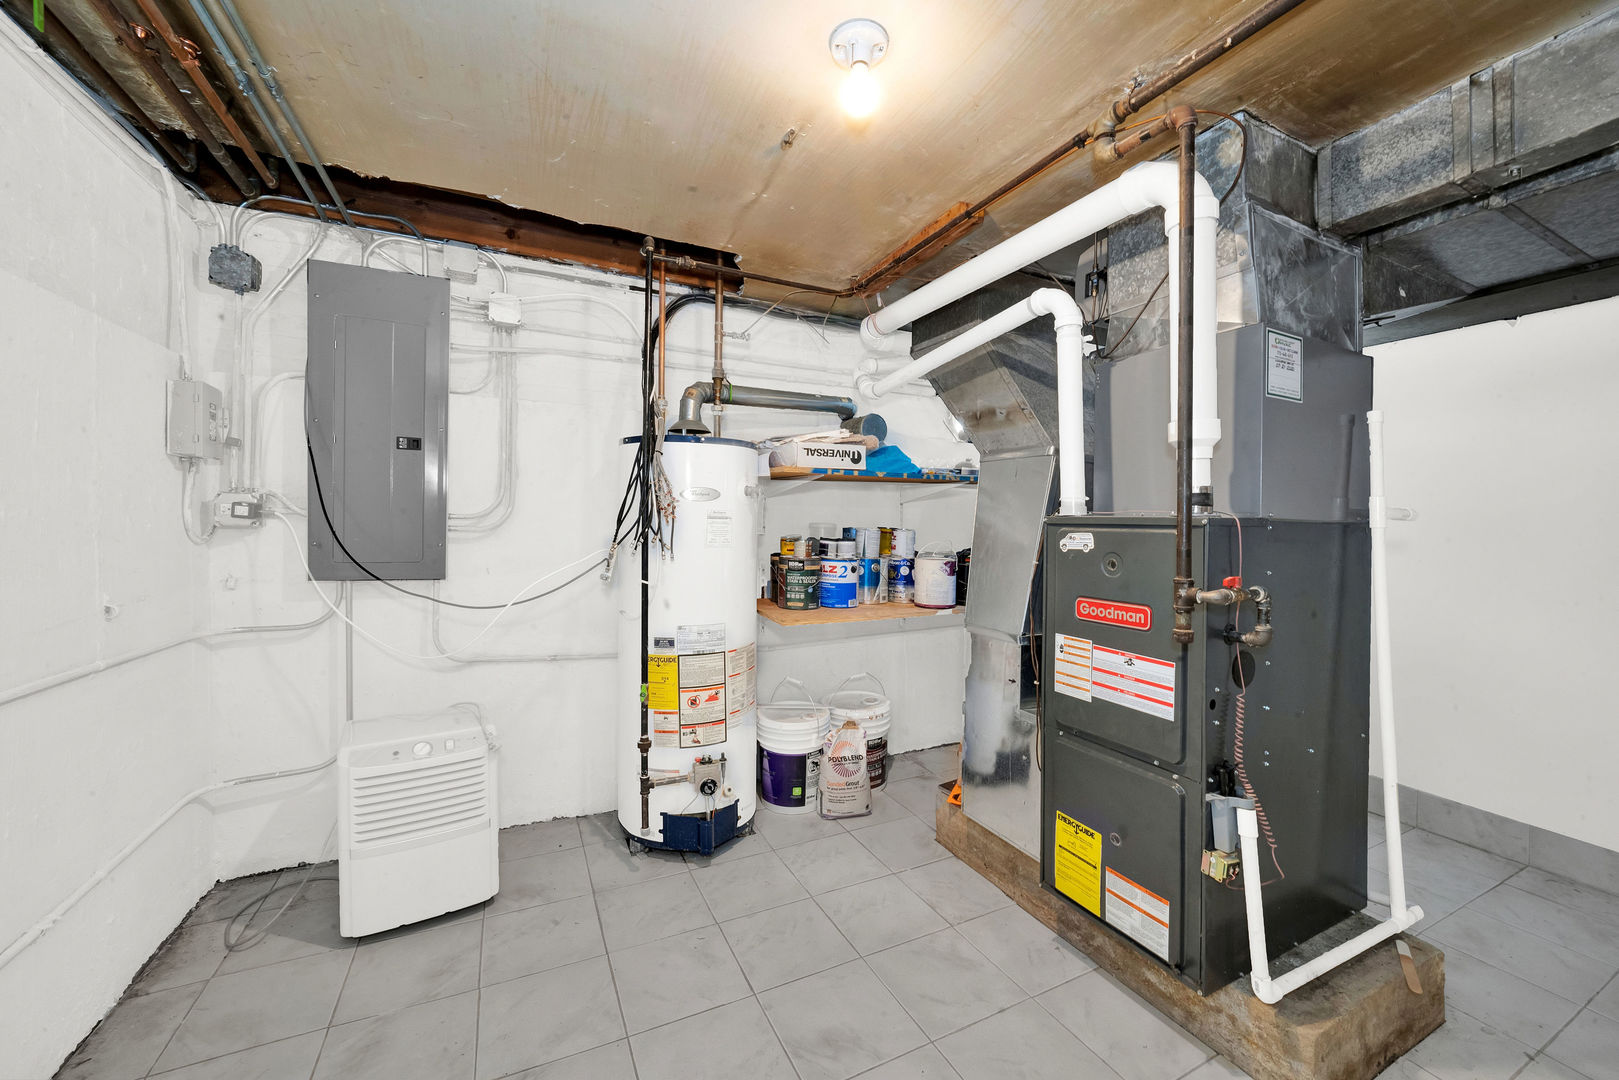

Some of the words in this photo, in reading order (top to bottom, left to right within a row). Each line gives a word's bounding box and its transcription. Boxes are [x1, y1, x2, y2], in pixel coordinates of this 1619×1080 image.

[821, 564, 838, 574] LZ
[838, 565, 848, 578] 2
[1079, 602, 1145, 624] Goodman
[648, 656, 678, 664] ERGYGUIDE
[827, 754, 864, 763] POLYBLEND
[1057, 813, 1096, 840] ENERGYGUIDE
